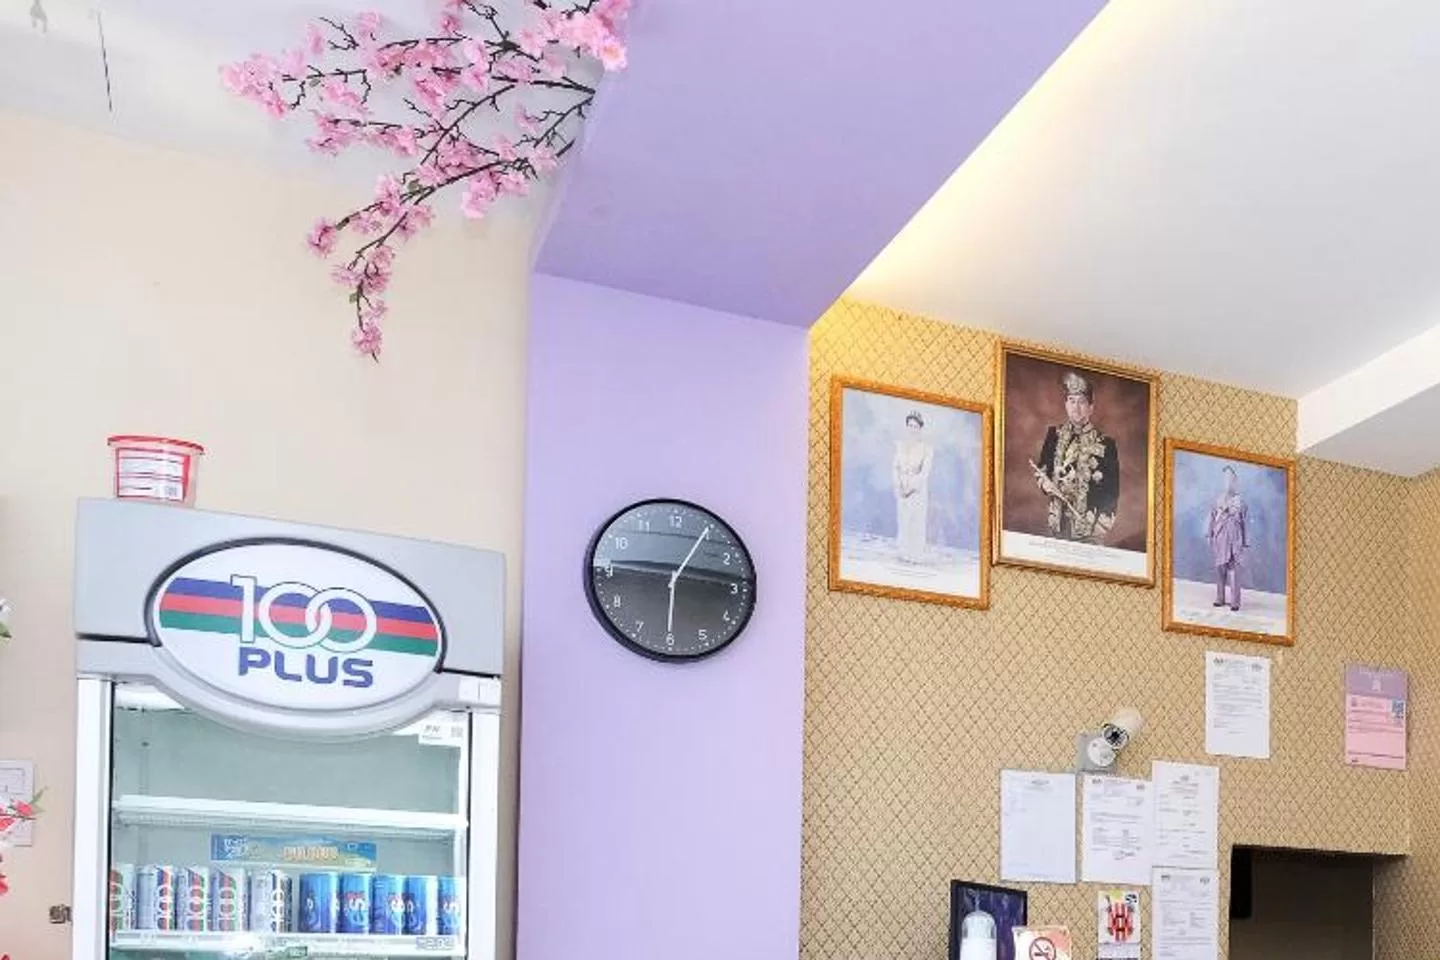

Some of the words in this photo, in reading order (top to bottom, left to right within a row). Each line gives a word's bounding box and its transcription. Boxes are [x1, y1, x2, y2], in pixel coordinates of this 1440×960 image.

[669, 516, 683, 529] 12
[722, 552, 731, 566] 2
[730, 583, 739, 595] 3
[613, 594, 621, 607] 8
[230, 574, 378, 654] 100
[635, 620, 644, 632] 7
[665, 633, 675, 646] 6
[698, 629, 709, 641] 5
[238, 646, 374, 689] PLUS
